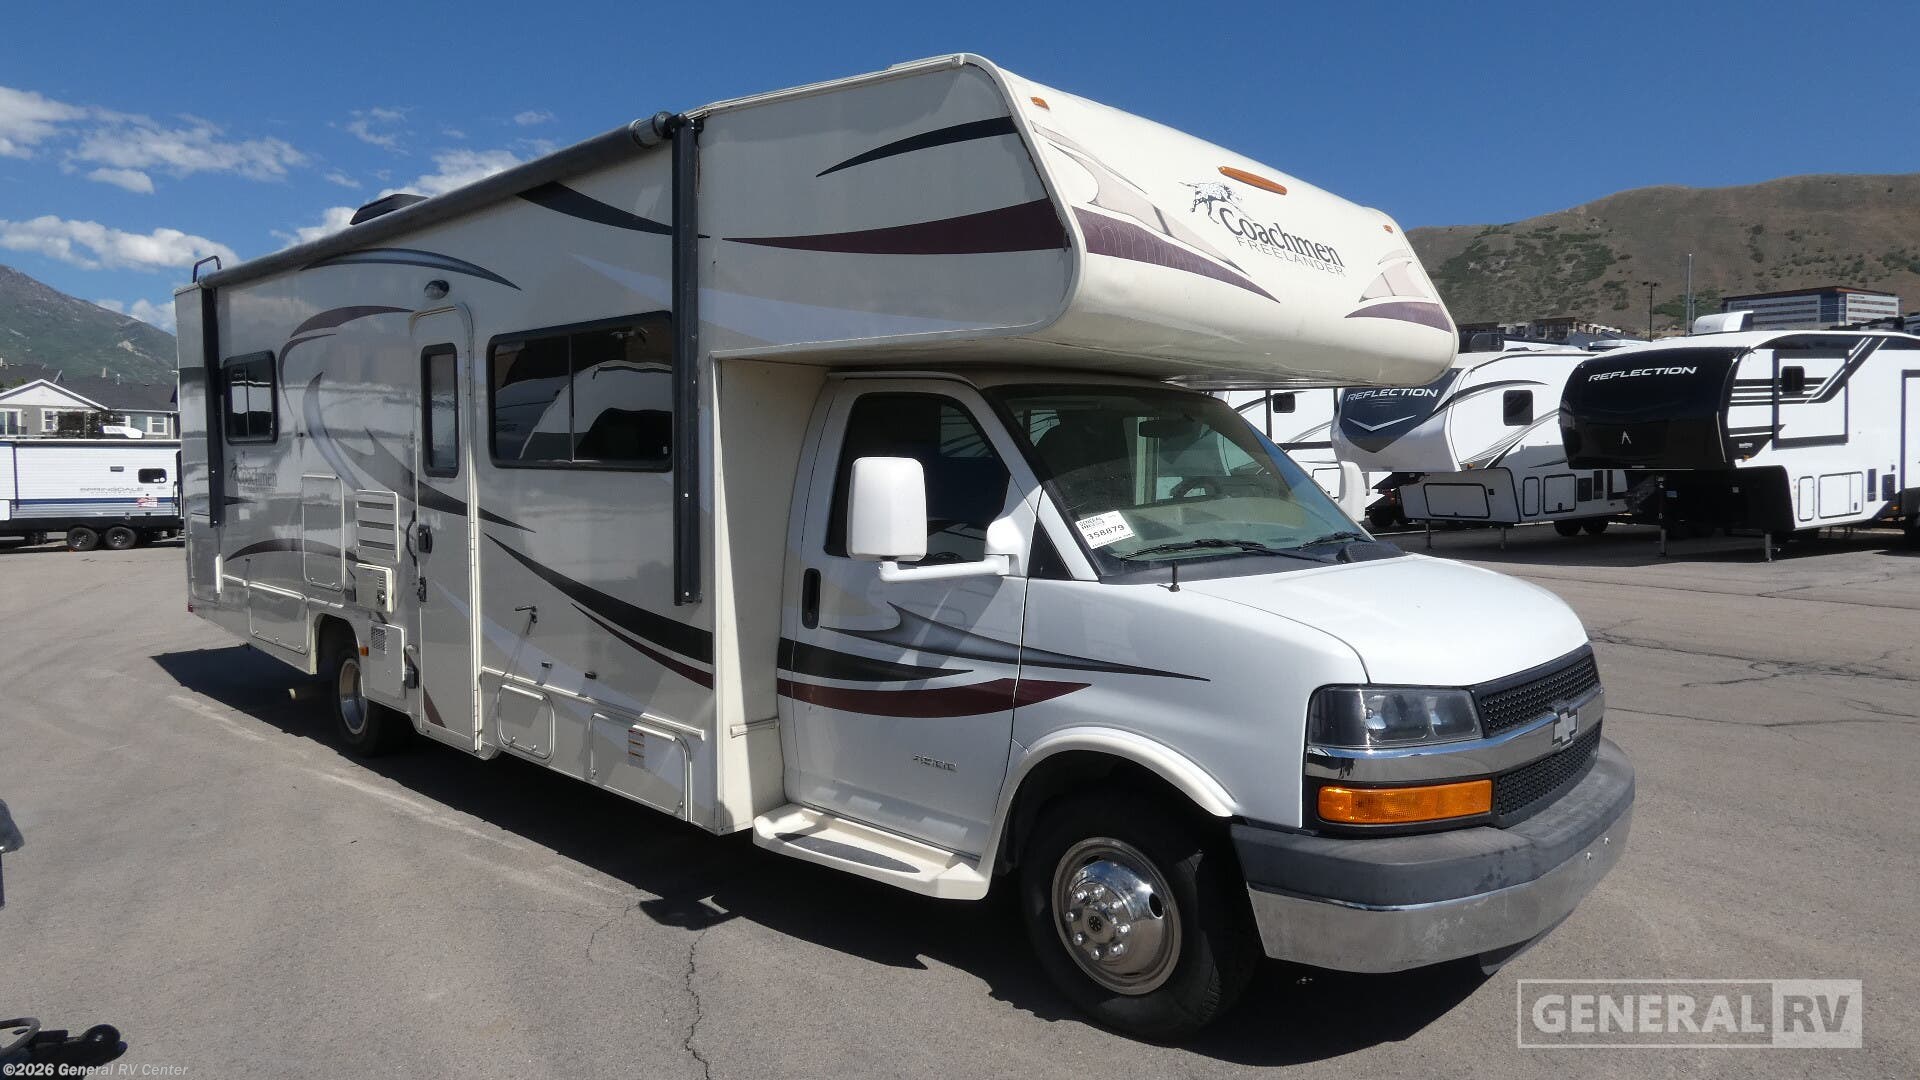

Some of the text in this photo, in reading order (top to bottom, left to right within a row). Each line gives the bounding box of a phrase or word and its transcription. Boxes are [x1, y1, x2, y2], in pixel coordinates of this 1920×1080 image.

[1219, 207, 1345, 268] Coachmen
[1235, 236, 1346, 278] FREELANDER
[1588, 366, 1698, 382] REFLECTION
[1346, 388, 1439, 402] REFLECTION
[1087, 524, 1125, 540] 358879
